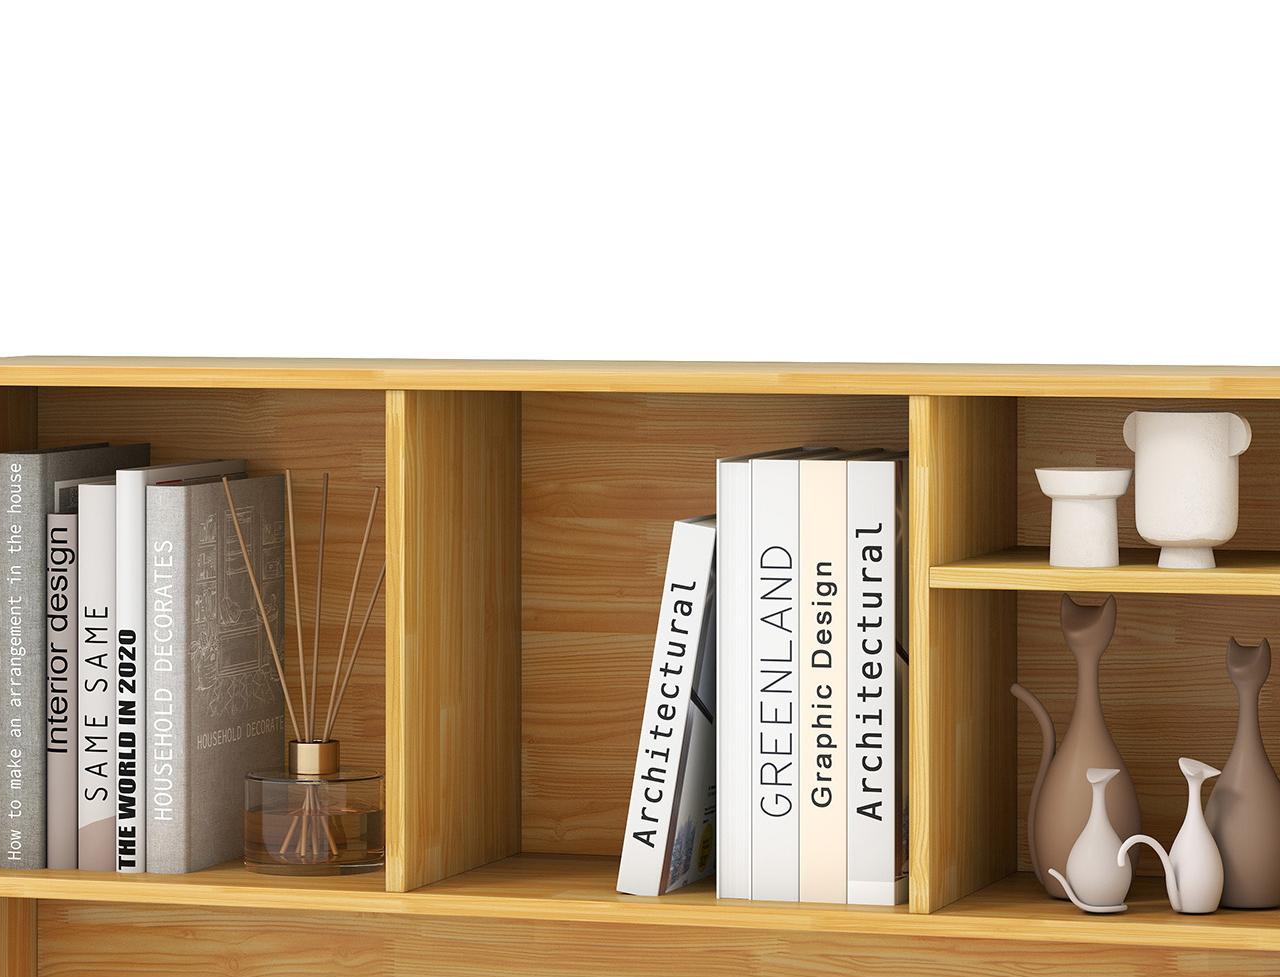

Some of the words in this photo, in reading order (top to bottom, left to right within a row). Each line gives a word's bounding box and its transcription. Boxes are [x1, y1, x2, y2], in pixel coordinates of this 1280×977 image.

[6, 463, 22, 513] house
[6, 523, 22, 554] the
[6, 565, 22, 585] in
[47, 527, 76, 632] design
[84, 606, 109, 693] SAME
[153, 540, 174, 672] DECORATES
[811, 561, 838, 669] Design
[7, 595, 26, 707] arrangement
[118, 629, 137, 694] 2020
[760, 546, 793, 818] GREENLAND
[855, 522, 883, 822] Architectural
[10, 717, 22, 738] an
[47, 642, 69, 753] Interior
[118, 700, 137, 725] IN
[196, 725, 242, 751] HOUSEHOLD
[632, 580, 697, 849] Architectural
[6, 748, 22, 790] make
[84, 714, 109, 802] SAME
[118, 731, 137, 820] WORLD
[153, 688, 174, 821] HOUSEHOLD
[811, 684, 838, 808] Graphic
[7, 800, 22, 819] to
[7, 829, 22, 861] How
[118, 825, 137, 871] THE
